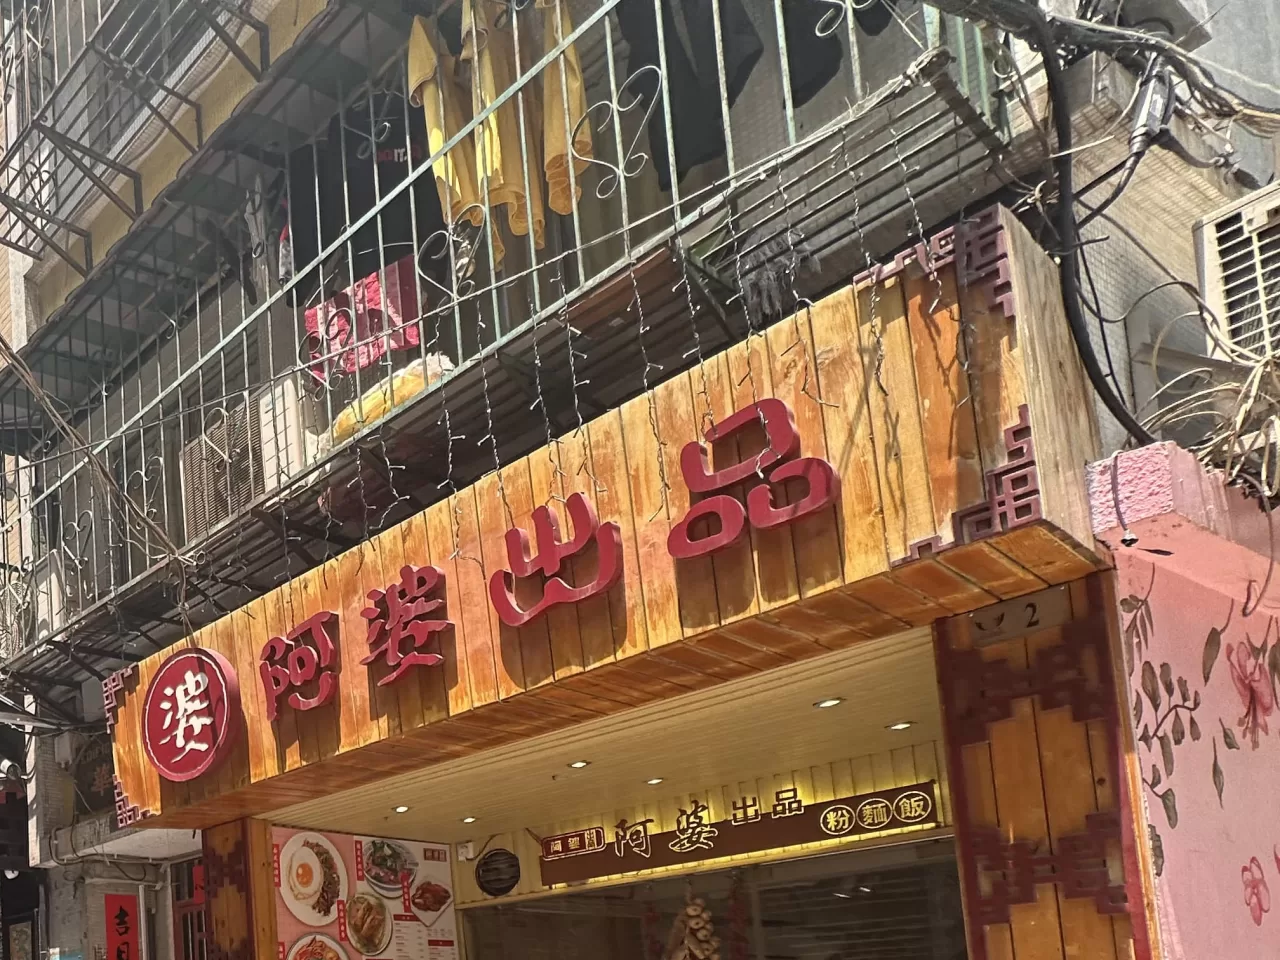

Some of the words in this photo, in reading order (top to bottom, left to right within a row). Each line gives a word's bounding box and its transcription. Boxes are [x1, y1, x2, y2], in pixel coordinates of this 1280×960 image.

[260, 397, 842, 722] 阿婆出品
[1024, 602, 1040, 628] 2
[158, 668, 214, 765] 婆
[614, 788, 804, 858] 阿婆出品
[825, 796, 927, 834] 粉麵飯
